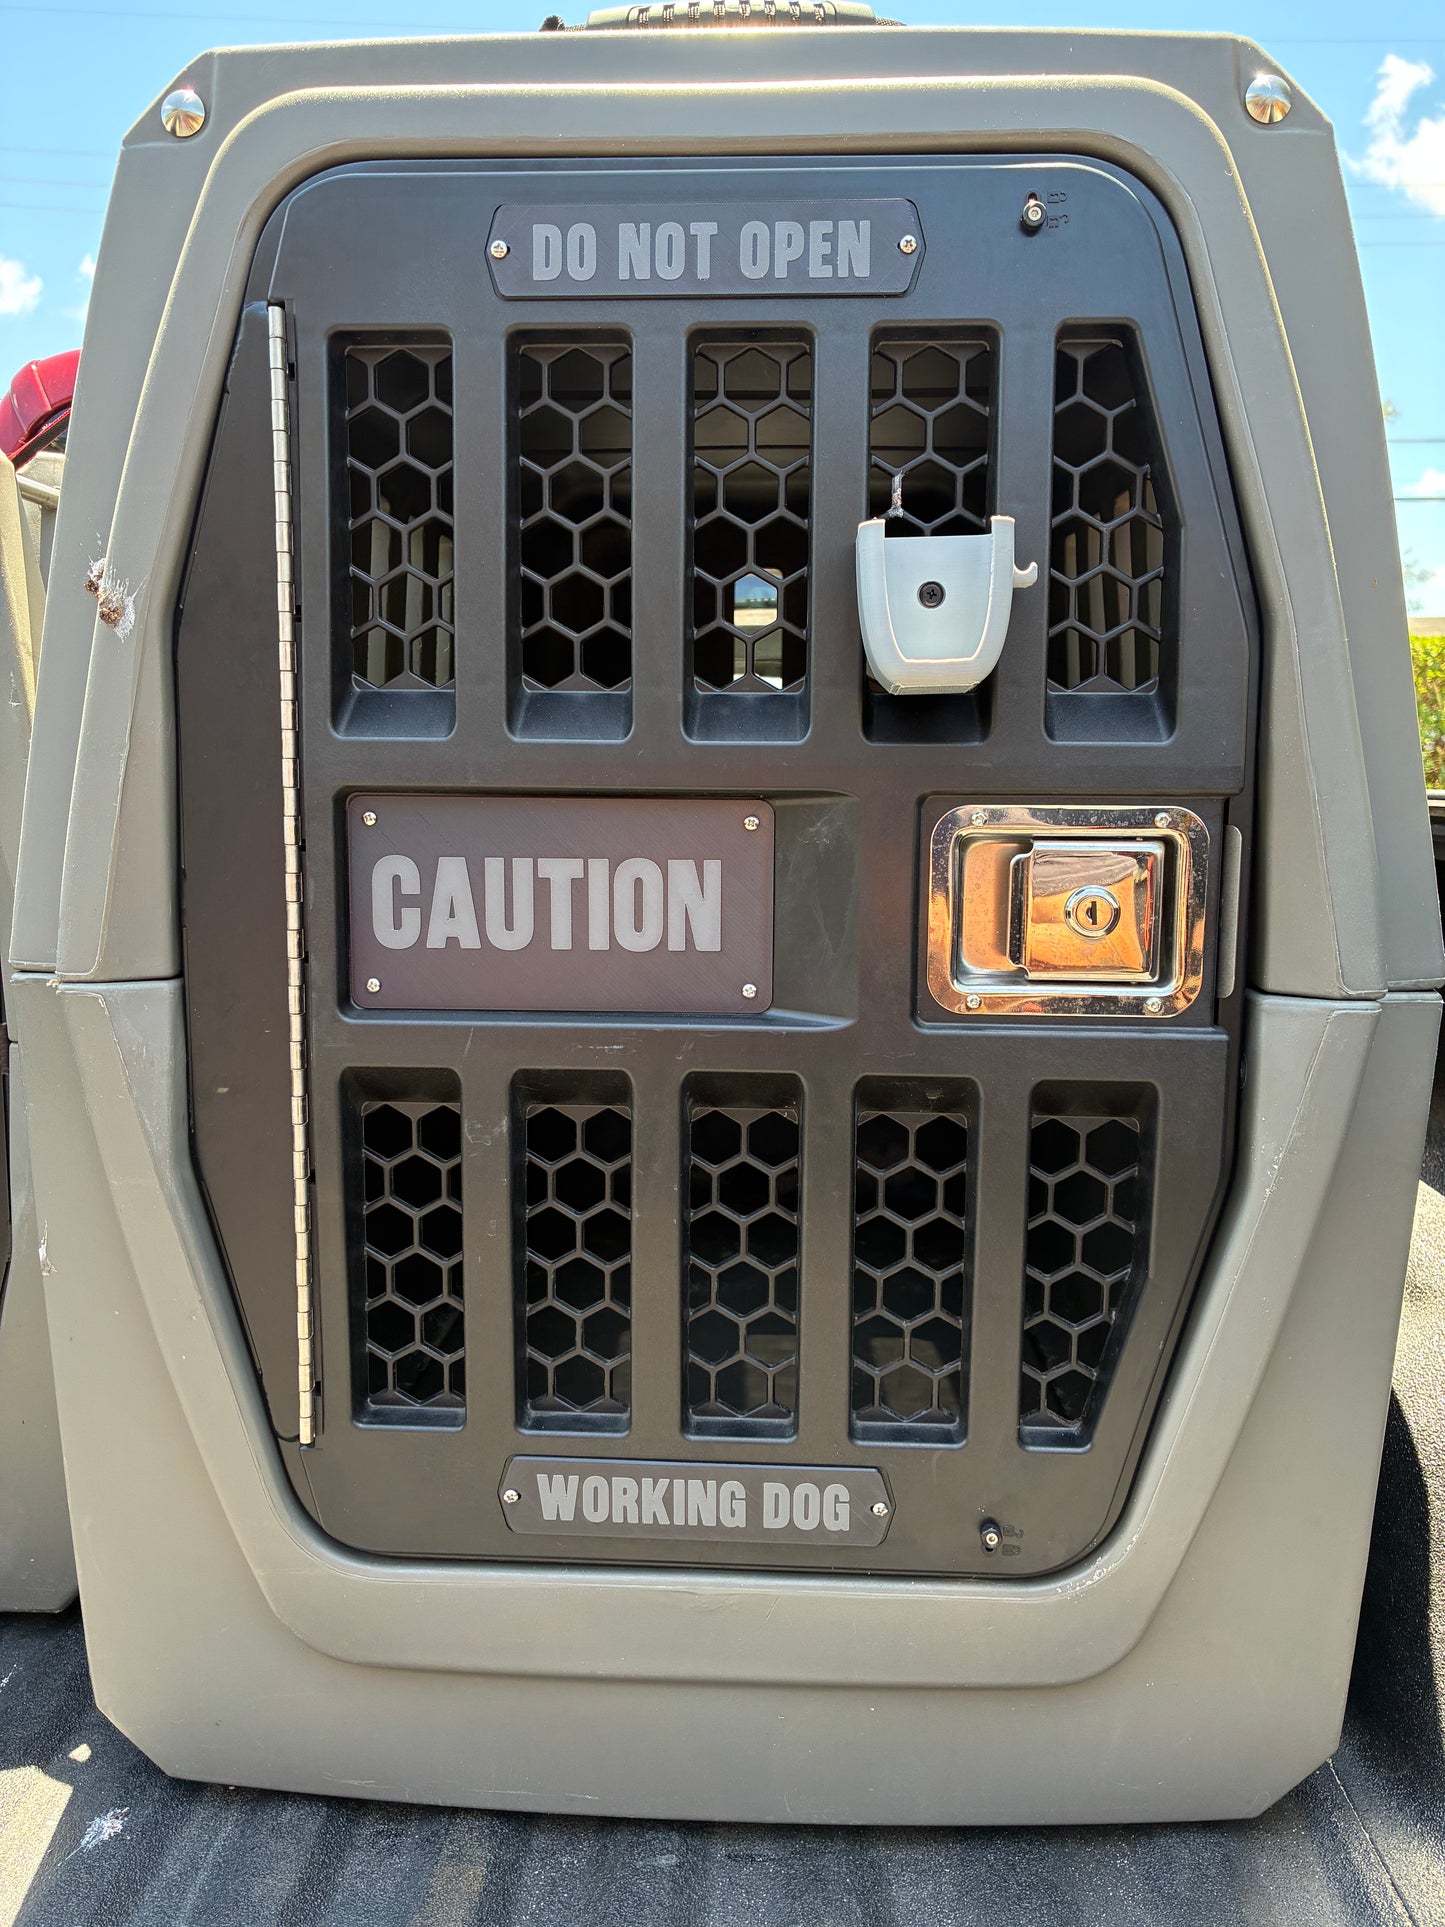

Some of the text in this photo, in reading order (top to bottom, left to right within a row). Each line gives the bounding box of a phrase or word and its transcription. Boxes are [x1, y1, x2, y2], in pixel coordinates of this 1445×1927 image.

[532, 220, 871, 282] DO NOT OPEN
[371, 854, 722, 953] CAUTION
[536, 1473, 850, 1531] WORKING DOG
